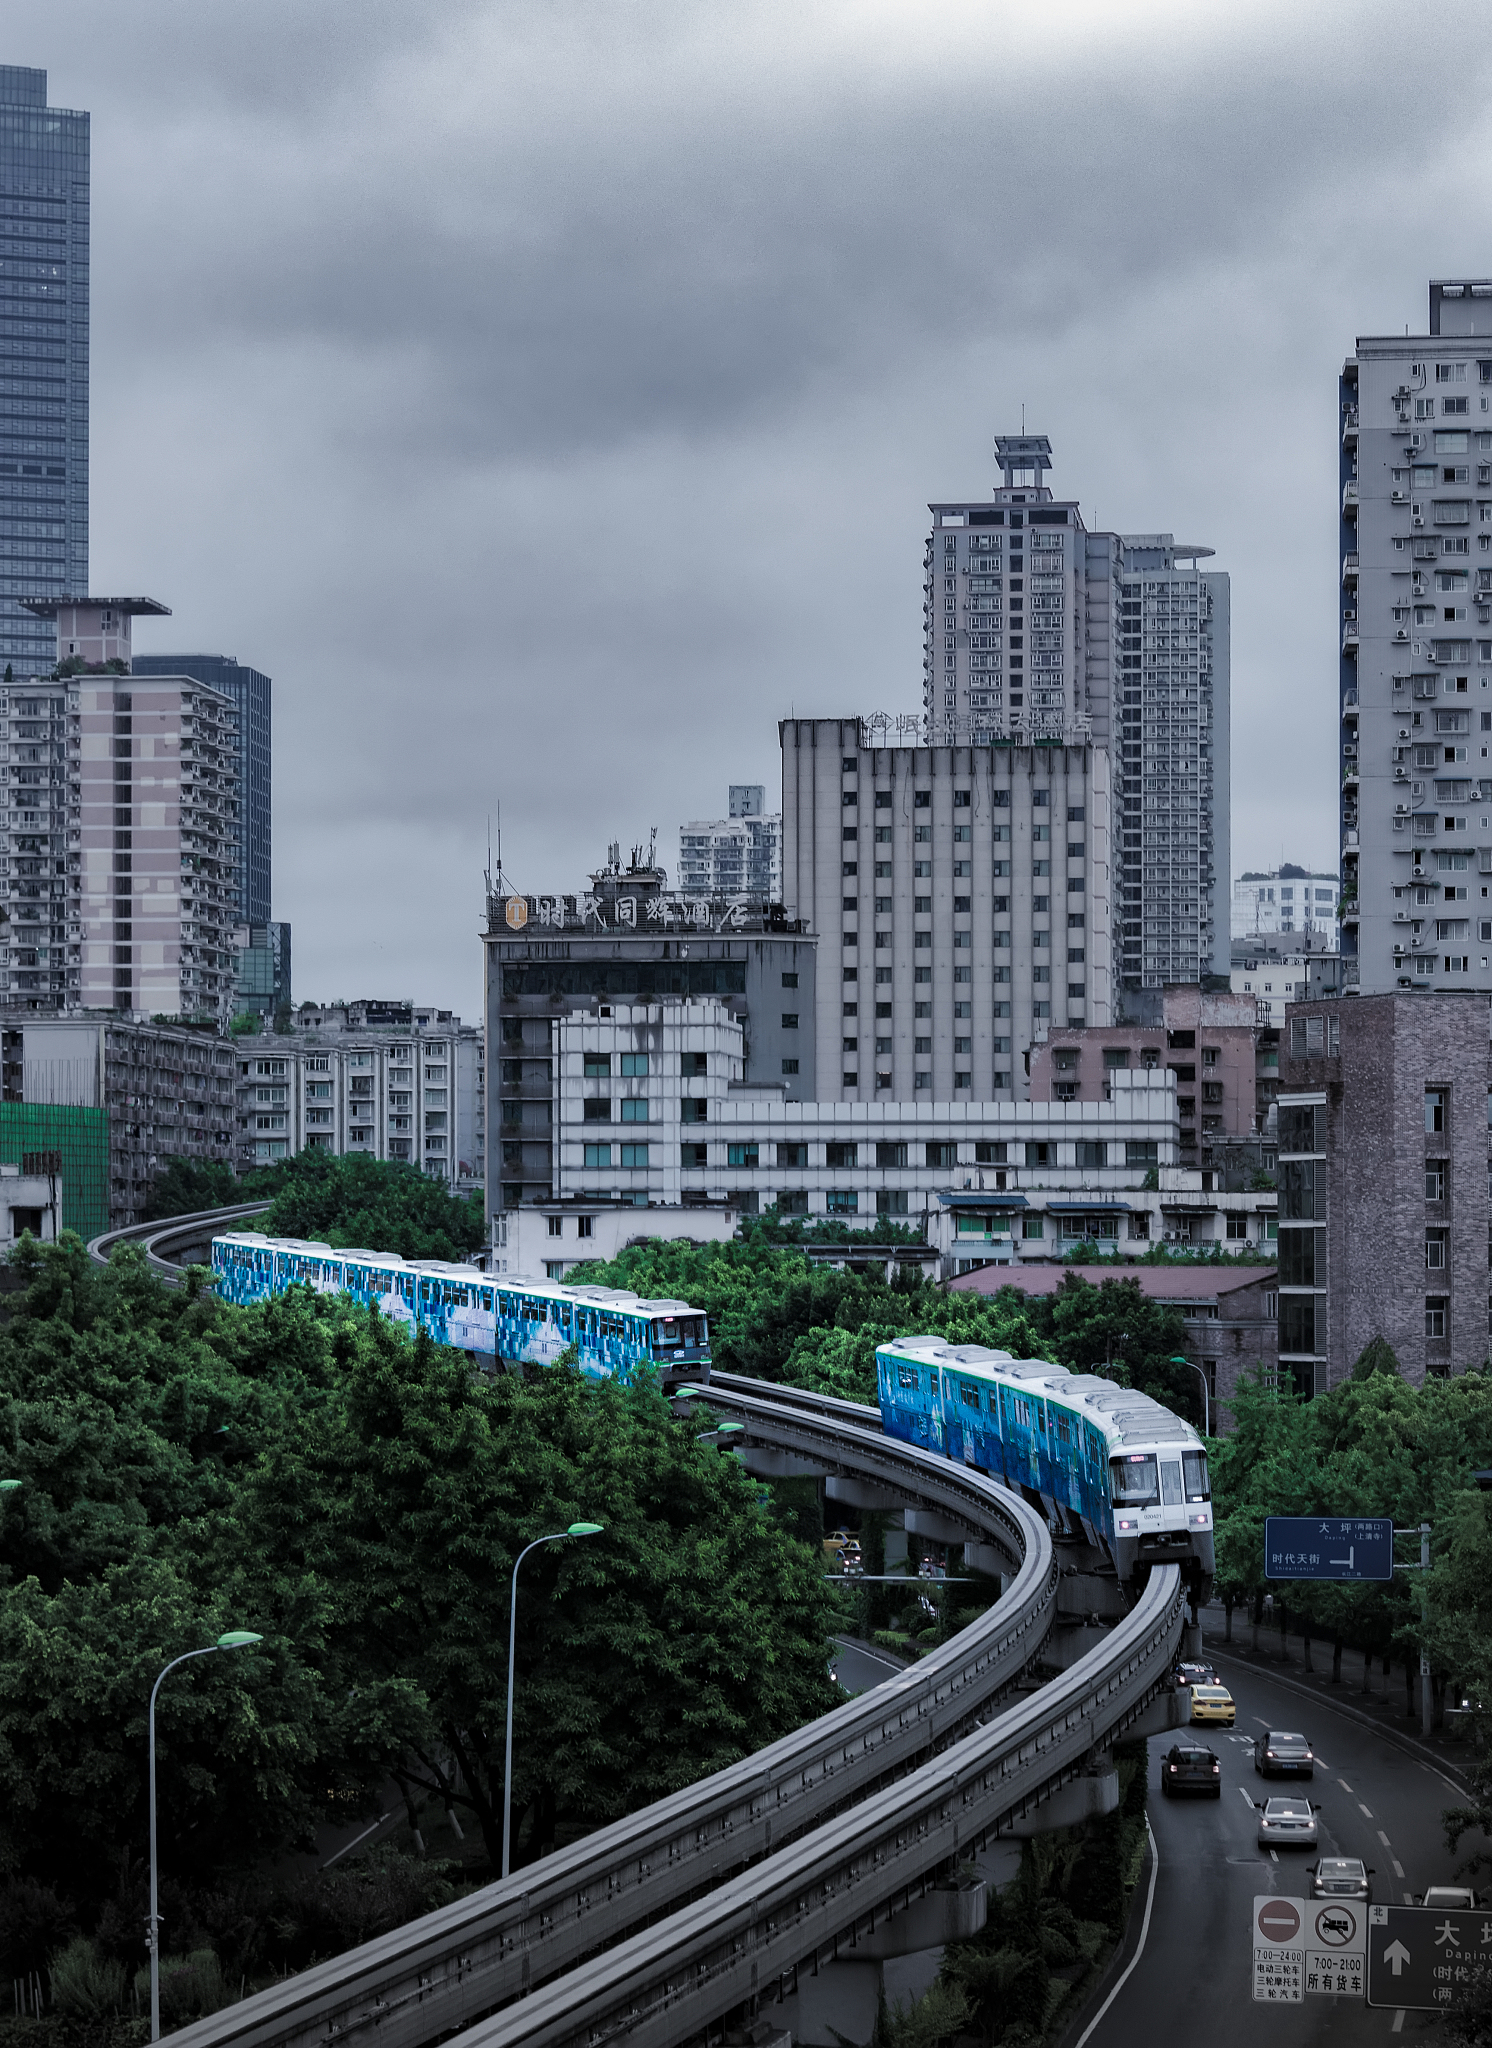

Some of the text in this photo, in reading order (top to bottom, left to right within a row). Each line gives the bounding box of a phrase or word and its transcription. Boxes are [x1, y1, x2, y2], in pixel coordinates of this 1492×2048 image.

[539, 896, 749, 929] 时代同辉酒店
[1319, 1522, 1352, 1534] 大坪
[1272, 1553, 1320, 1565] 时代天街
[1373, 1907, 1384, 1917] 北
[1257, 1963, 1300, 1975] 电动三轮车
[1257, 1976, 1300, 1987] 三轮摩托车
[1307, 1973, 1362, 1992] 所有货车
[1256, 1988, 1301, 2000] 三轮汽车
